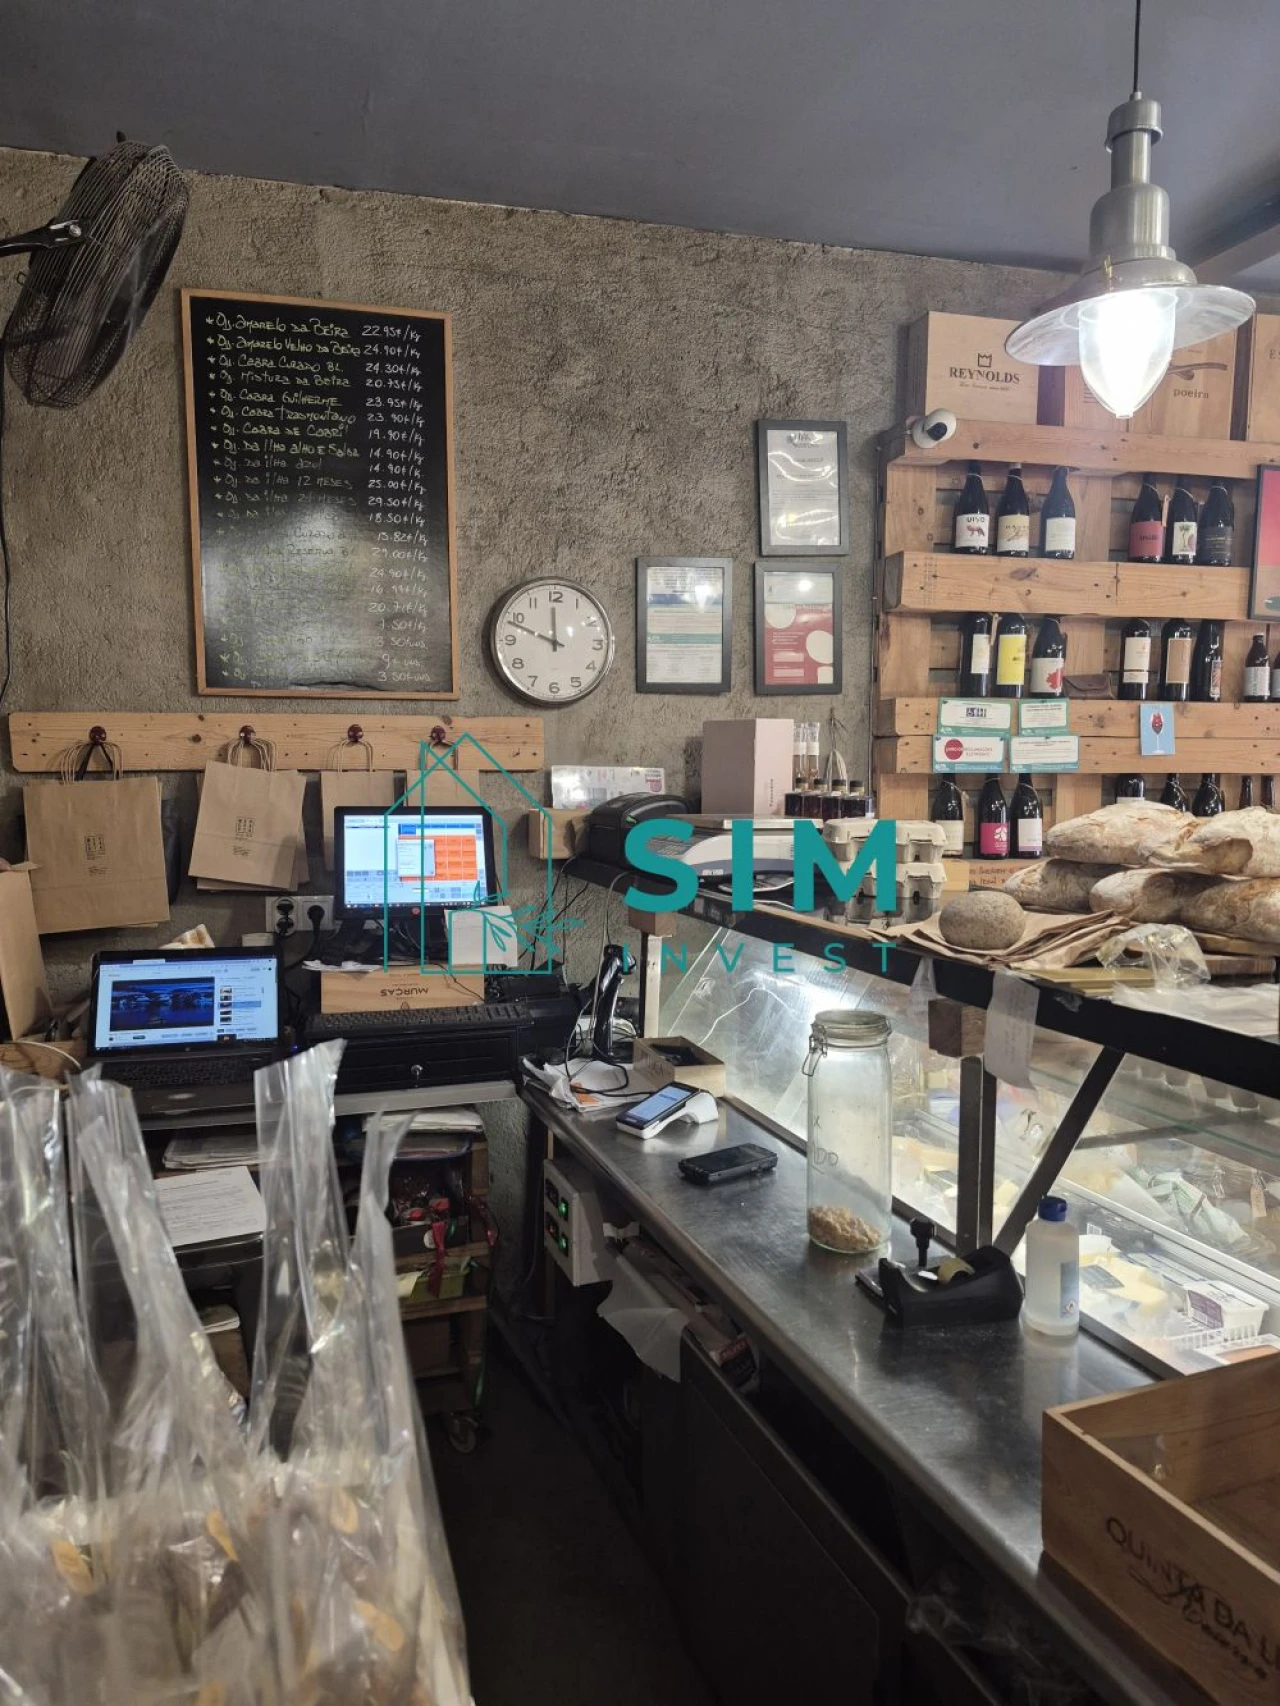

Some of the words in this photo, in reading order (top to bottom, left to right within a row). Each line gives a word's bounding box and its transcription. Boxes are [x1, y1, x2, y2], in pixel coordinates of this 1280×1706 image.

[949, 366, 1020, 384] REYNOLDS
[549, 591, 563, 603] 12
[530, 598, 537, 608] 11
[513, 612, 525, 623] 10
[505, 635, 516, 646] 9
[592, 640, 603, 650] 3
[512, 658, 524, 669] 8
[586, 661, 596, 672] 4
[528, 676, 538, 687] 7
[570, 677, 581, 688] 5
[549, 682, 560, 694] 6
[1106, 1517, 1206, 1612] QUINTA
